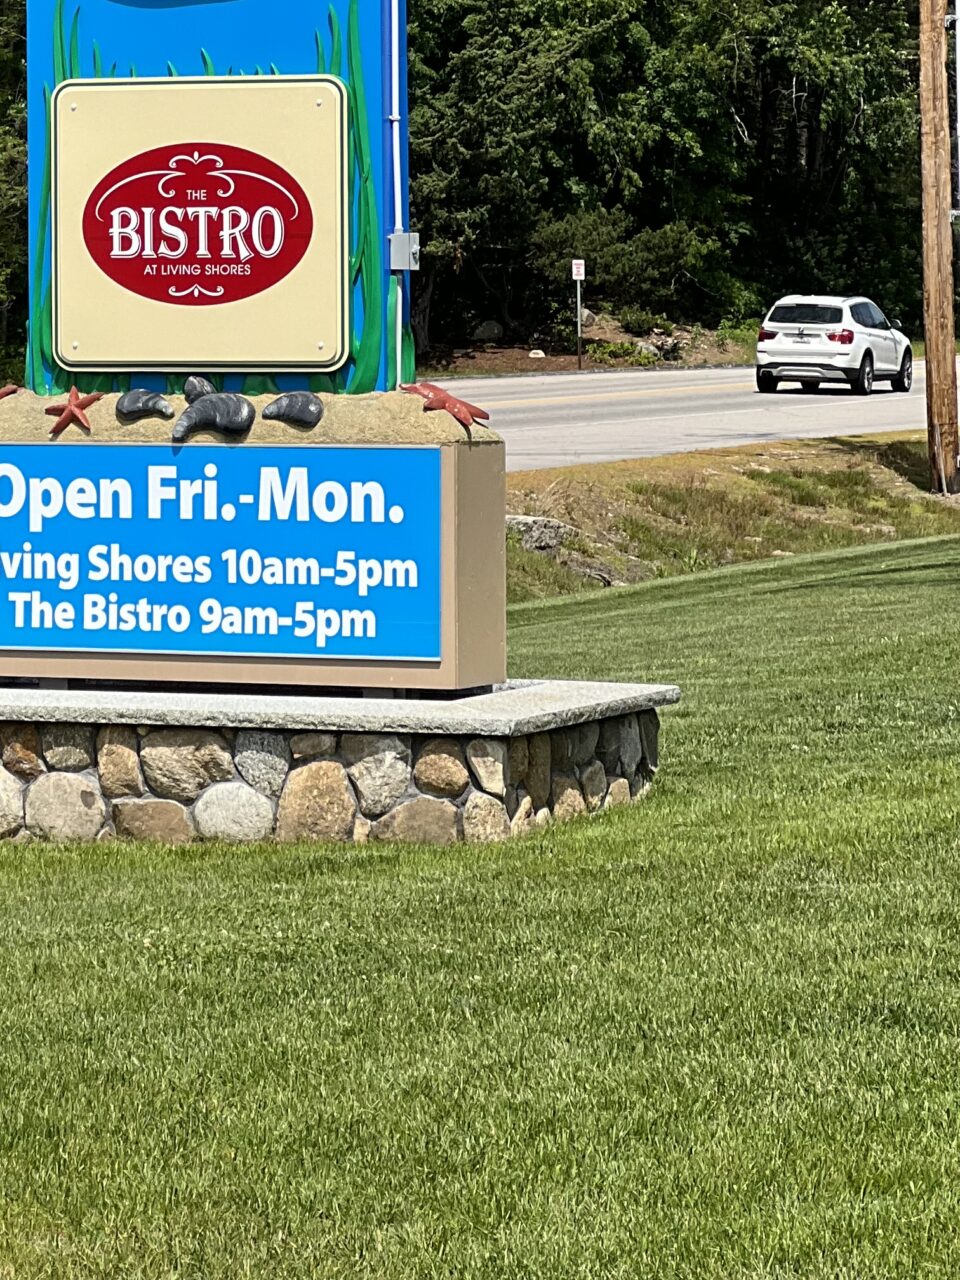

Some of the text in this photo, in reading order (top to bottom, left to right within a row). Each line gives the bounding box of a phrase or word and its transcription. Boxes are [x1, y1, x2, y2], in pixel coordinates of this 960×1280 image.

[186, 189, 207, 201] THE
[108, 205, 285, 262] BISTRO
[143, 264, 251, 275] AT LIVING SHORES
[147, 463, 404, 524] Fri.-Mon.
[87, 543, 212, 584] Shores
[221, 548, 418, 596] 10am-5pm
[8, 592, 376, 647] The Bistro 9am-5pm
